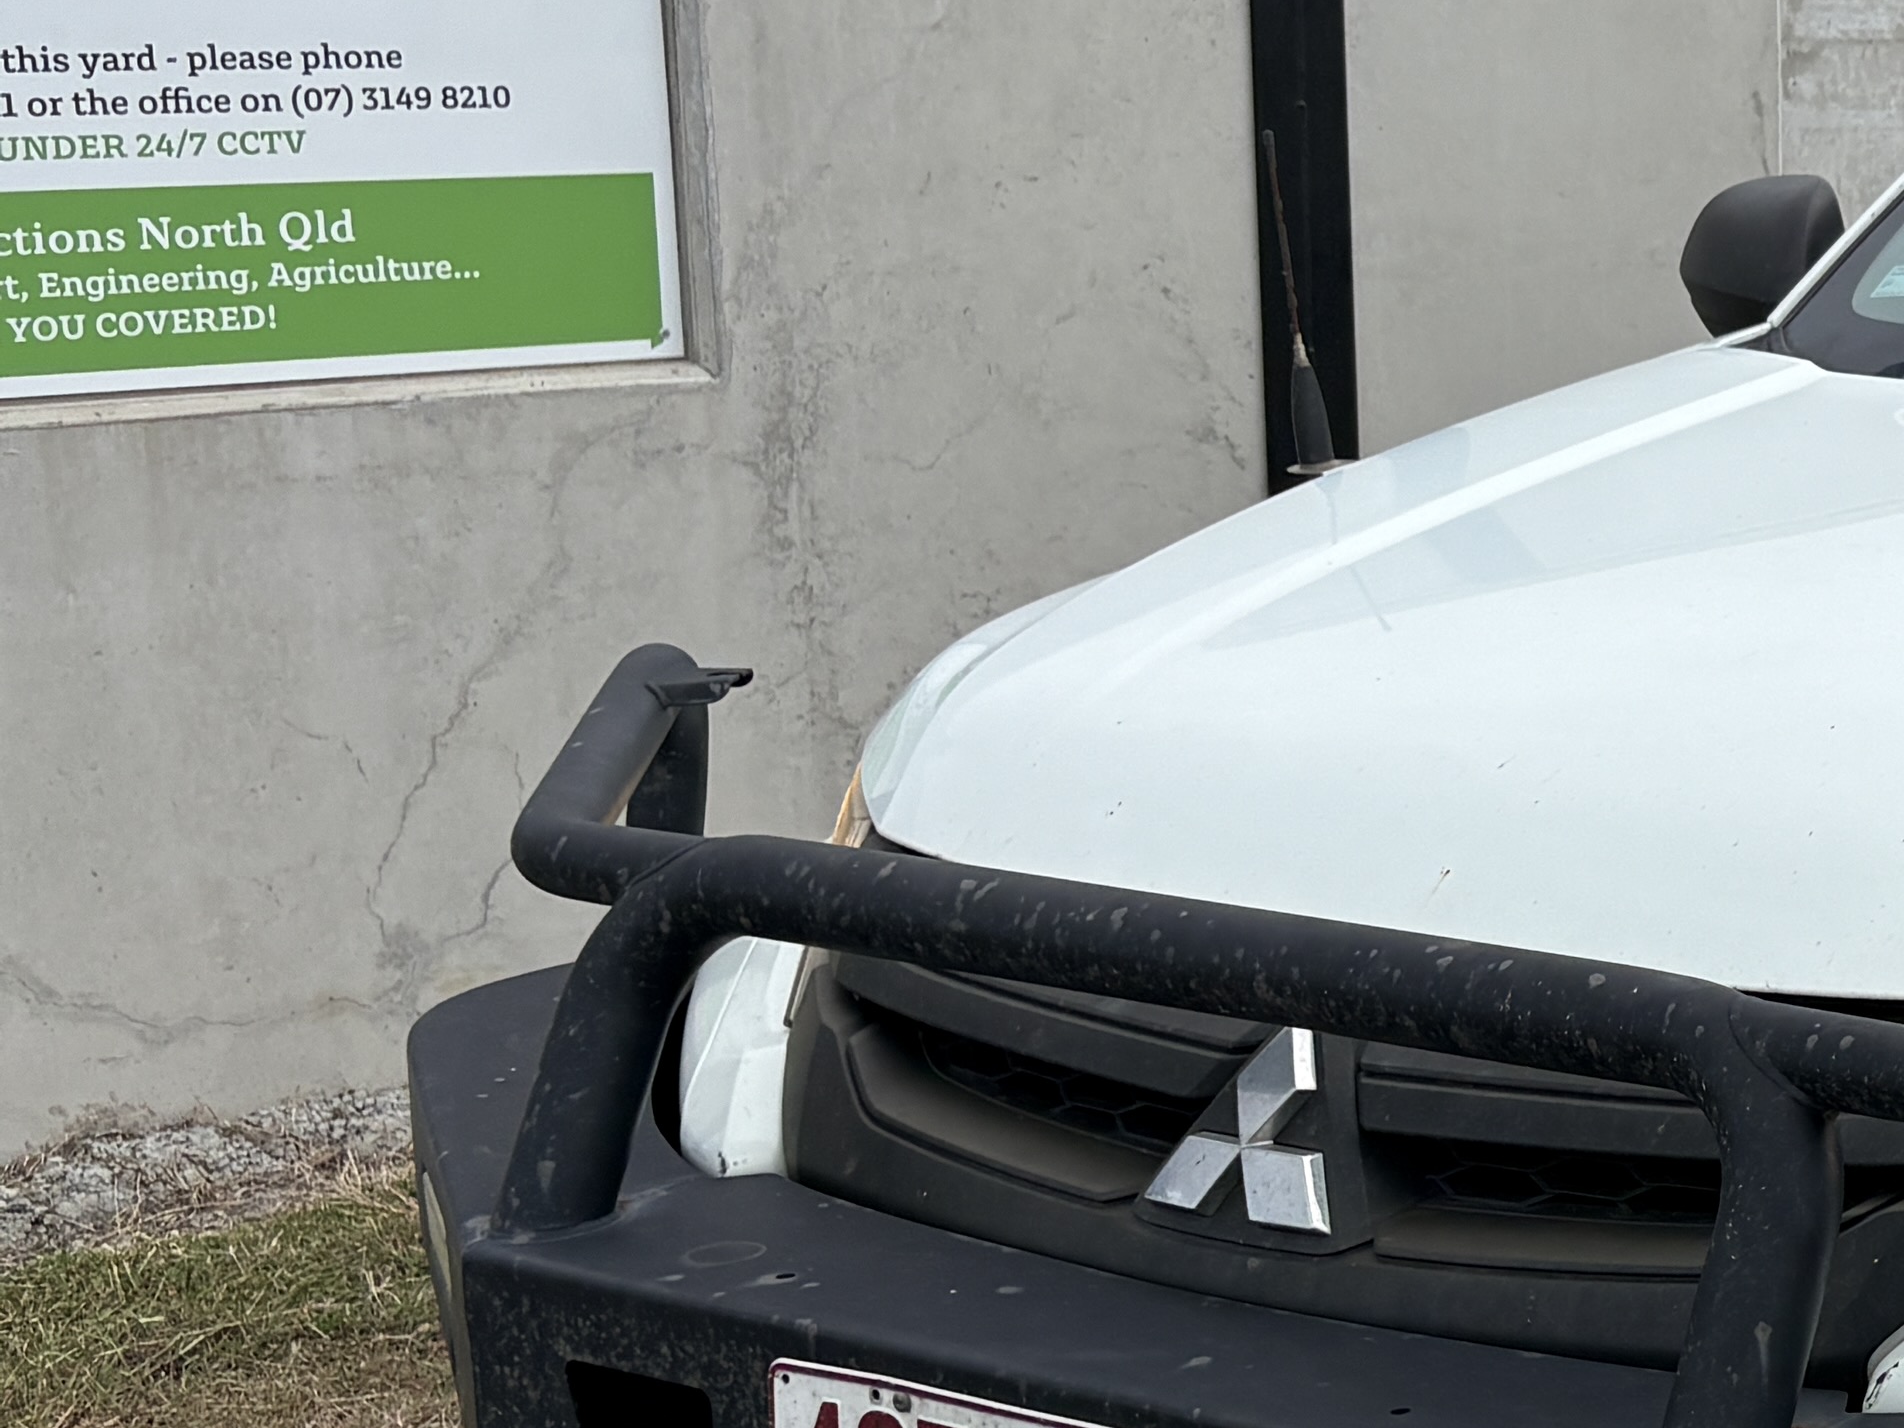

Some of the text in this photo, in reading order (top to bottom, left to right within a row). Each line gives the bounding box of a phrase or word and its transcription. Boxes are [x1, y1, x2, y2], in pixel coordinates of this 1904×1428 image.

[0, 45, 69, 73] this
[78, 44, 157, 79] yard
[187, 44, 291, 77] please
[301, 43, 402, 75] phone
[28, 98, 63, 116] or
[72, 88, 128, 115] the
[139, 87, 230, 114] office
[241, 94, 283, 112] on
[292, 84, 353, 118] (07)
[362, 87, 431, 110] 3149
[442, 86, 510, 109] 8210
[0, 129, 306, 161] UNDER 24/7 CCTV
[138, 212, 265, 249] North
[279, 209, 355, 251] Qld
[38, 264, 258, 301] Engineering,
[268, 253, 480, 288] Agriculture...
[6, 305, 276, 342] YOU COVERED!
